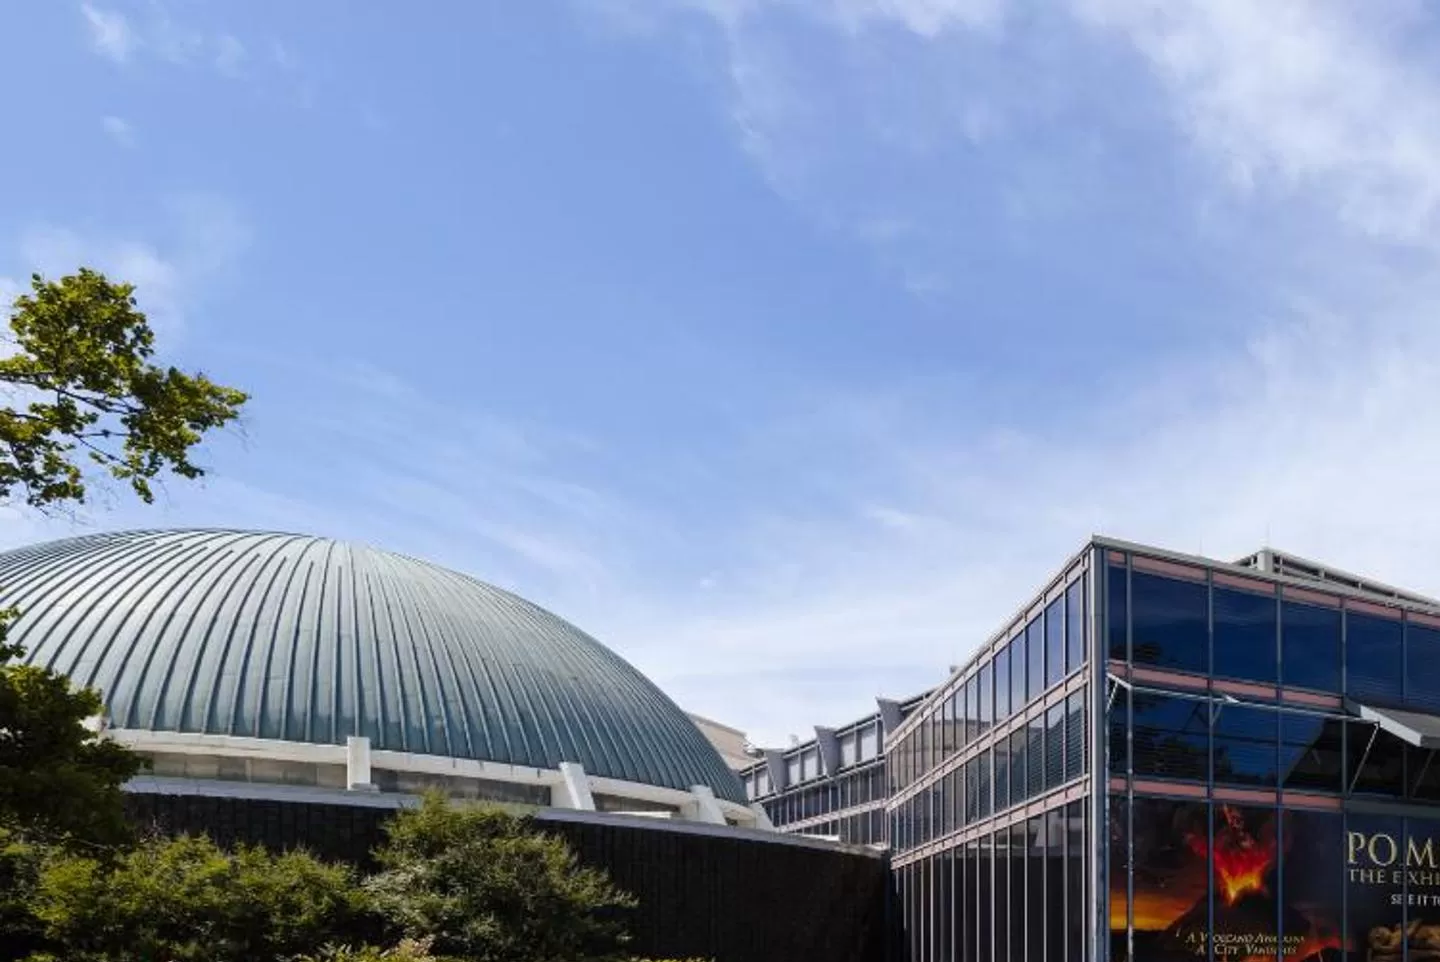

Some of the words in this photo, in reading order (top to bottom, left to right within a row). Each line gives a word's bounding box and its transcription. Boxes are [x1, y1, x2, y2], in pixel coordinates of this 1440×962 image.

[1350, 868, 1386, 884] THE
[1391, 894, 1414, 905] SEE
[1417, 895, 1428, 906] IT
